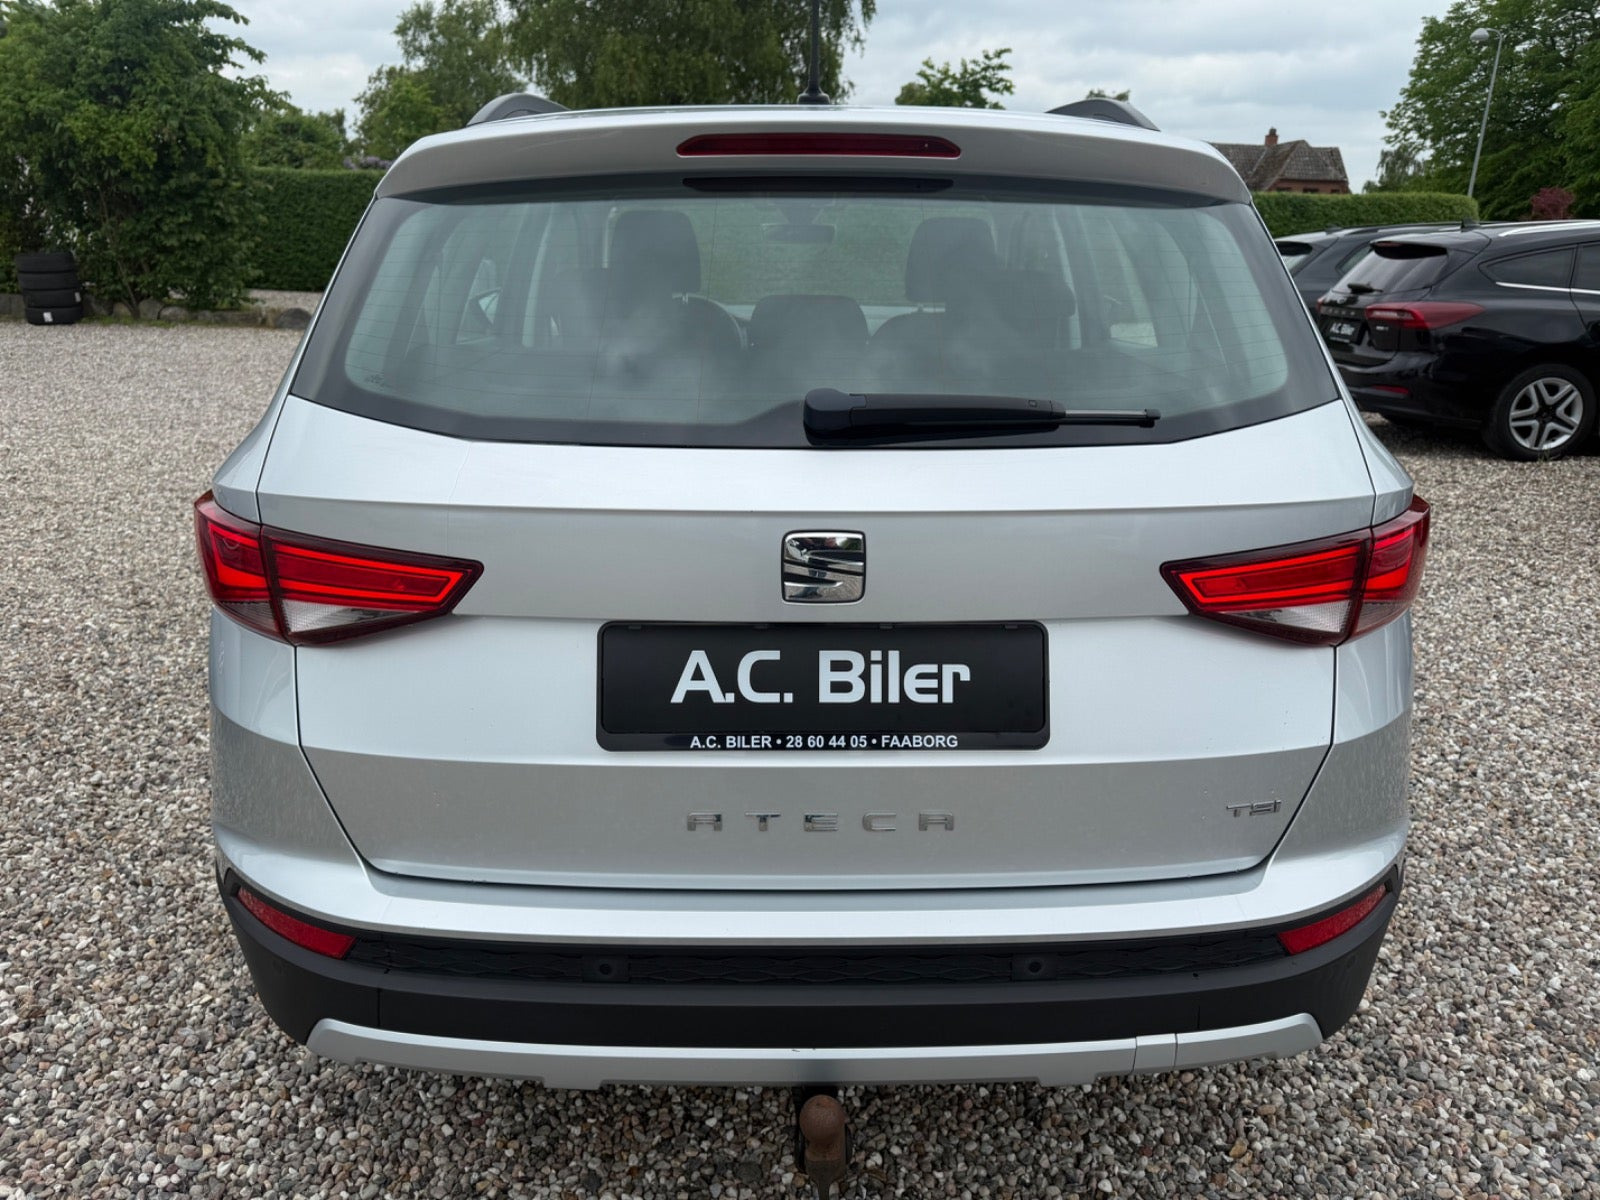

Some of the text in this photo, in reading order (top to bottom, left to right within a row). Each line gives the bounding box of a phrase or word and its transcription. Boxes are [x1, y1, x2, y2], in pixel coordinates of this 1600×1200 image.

[670, 650, 971, 703] A.C. Biler
[690, 734, 958, 749] A.C. BILER 28 60 44 05 FAABORG
[687, 811, 955, 832] ATECA
